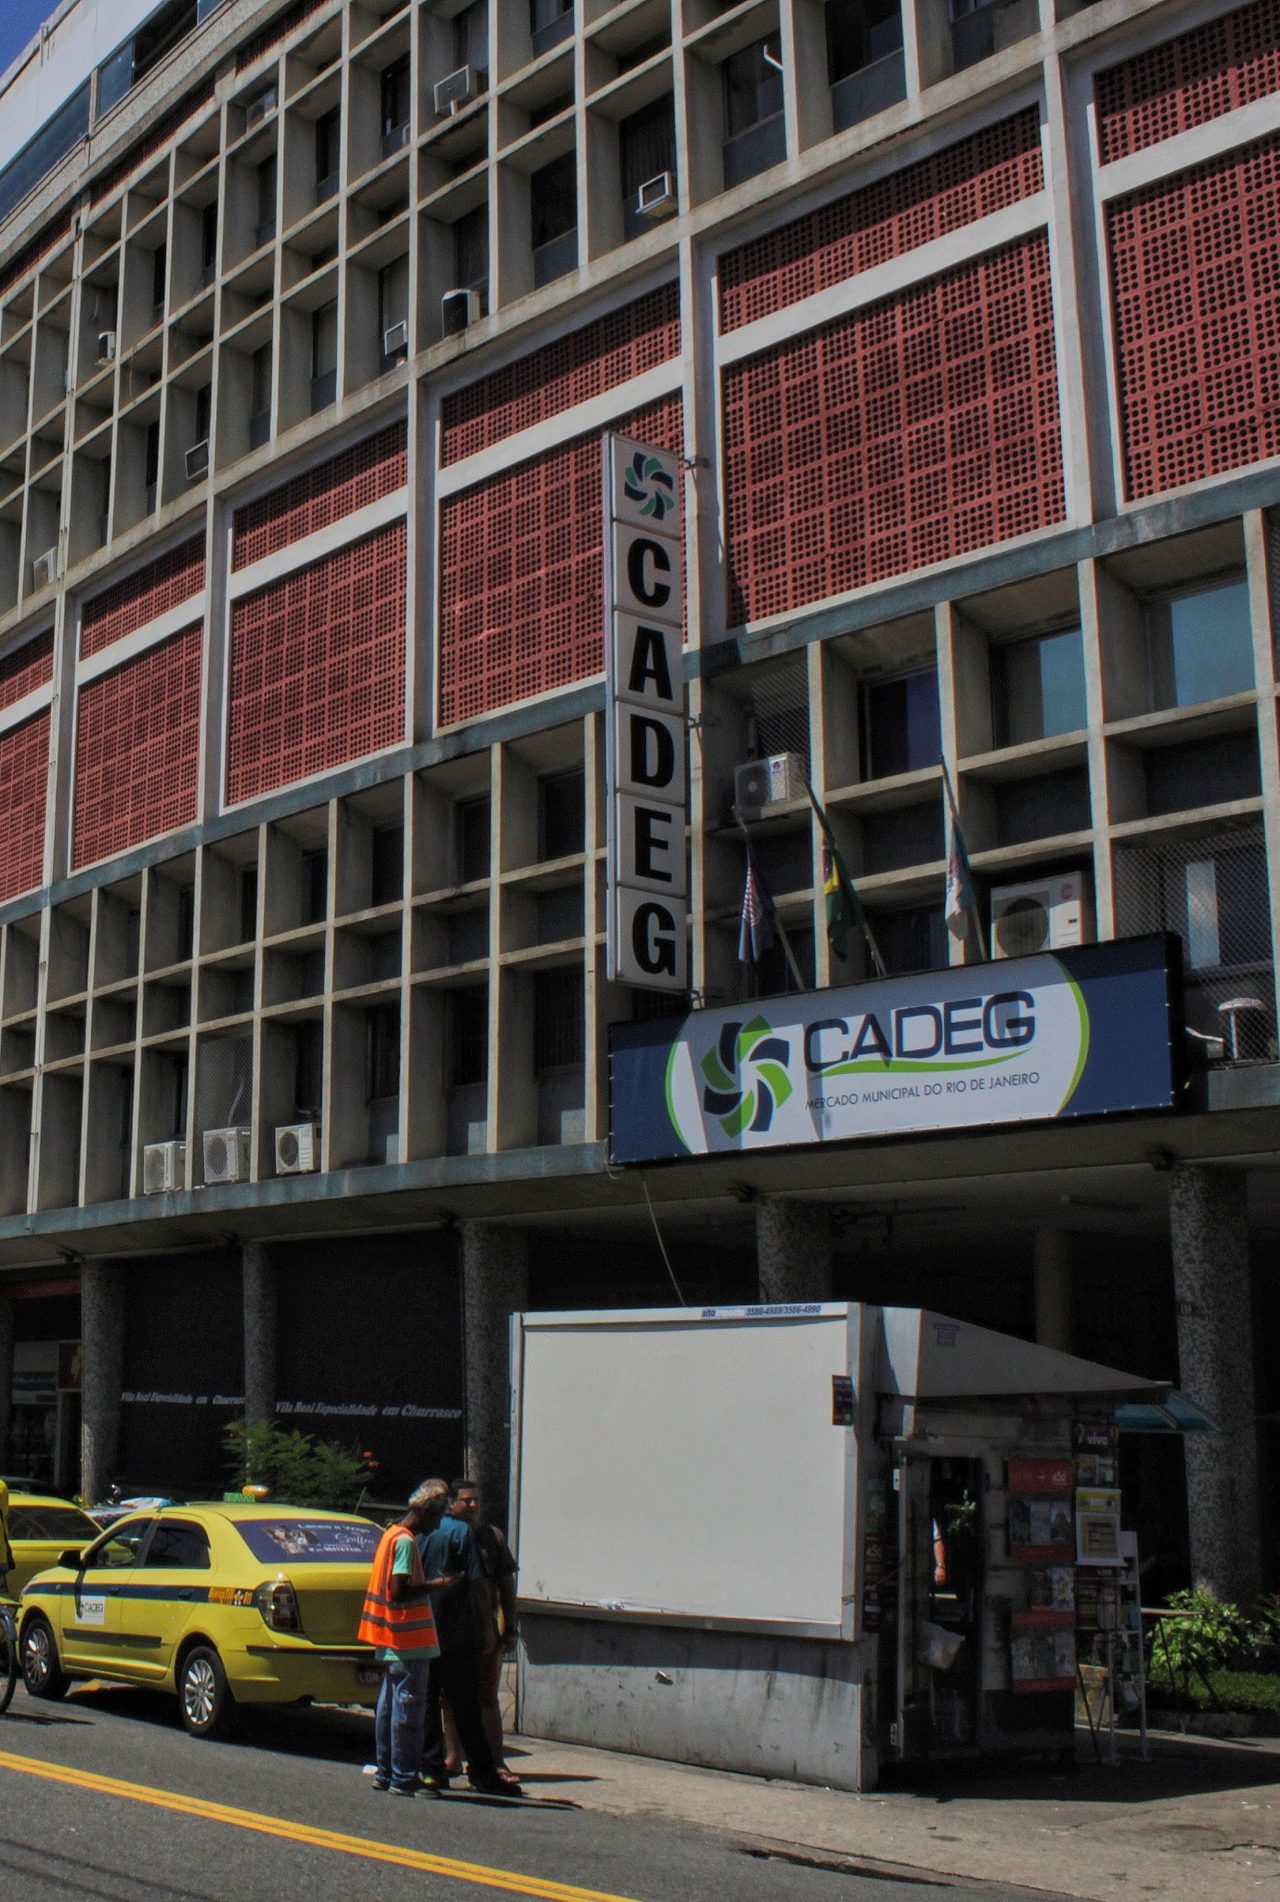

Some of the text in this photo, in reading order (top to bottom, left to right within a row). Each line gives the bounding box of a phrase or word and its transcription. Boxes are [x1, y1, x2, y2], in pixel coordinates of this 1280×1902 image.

[627, 538, 676, 976] CADEG
[803, 991, 1036, 1072] CADEG
[805, 1071, 1040, 1110] MERCADO MUNICIPAL DO RIO DE JANEIRO
[275, 1401, 462, 1419] Vila Real Especialidade em Churrasco
[224, 1492, 255, 1503] TAXI
